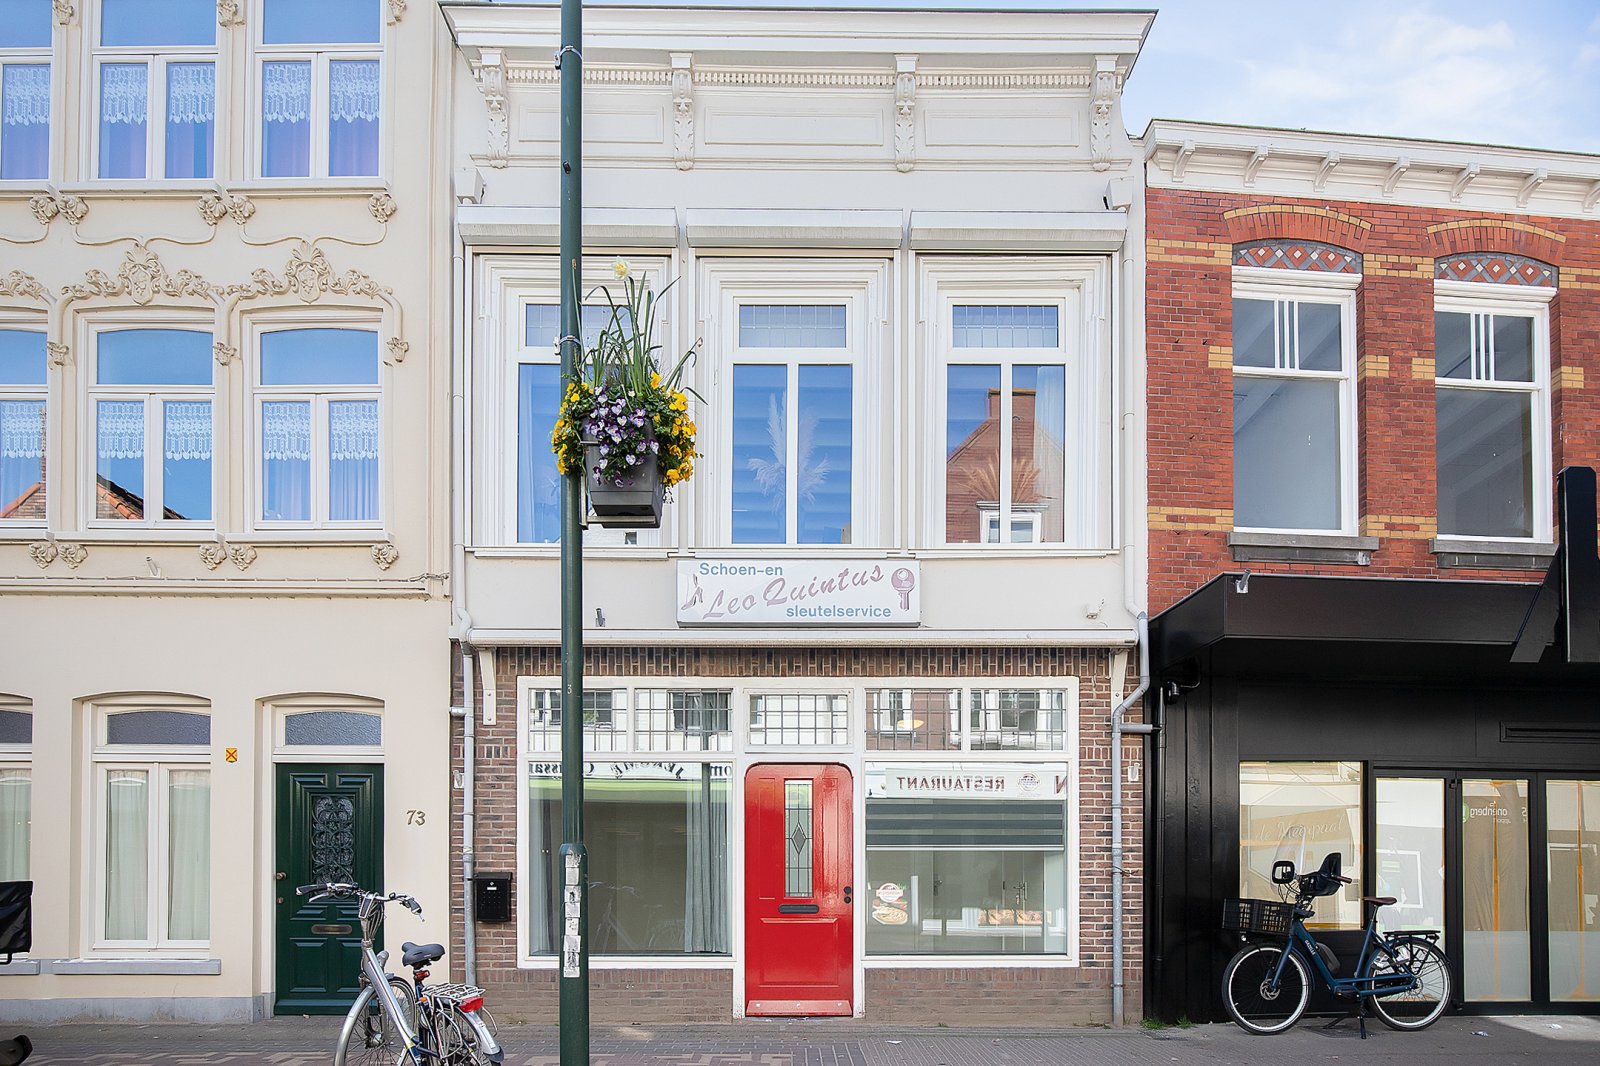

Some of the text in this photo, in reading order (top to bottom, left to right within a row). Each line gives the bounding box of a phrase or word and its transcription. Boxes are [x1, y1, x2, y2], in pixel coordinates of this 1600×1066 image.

[699, 562, 783, 576] Schoen-en
[702, 564, 884, 620] Leo Quintus
[786, 605, 892, 617] sleutelservice
[406, 809, 426, 826] 73
